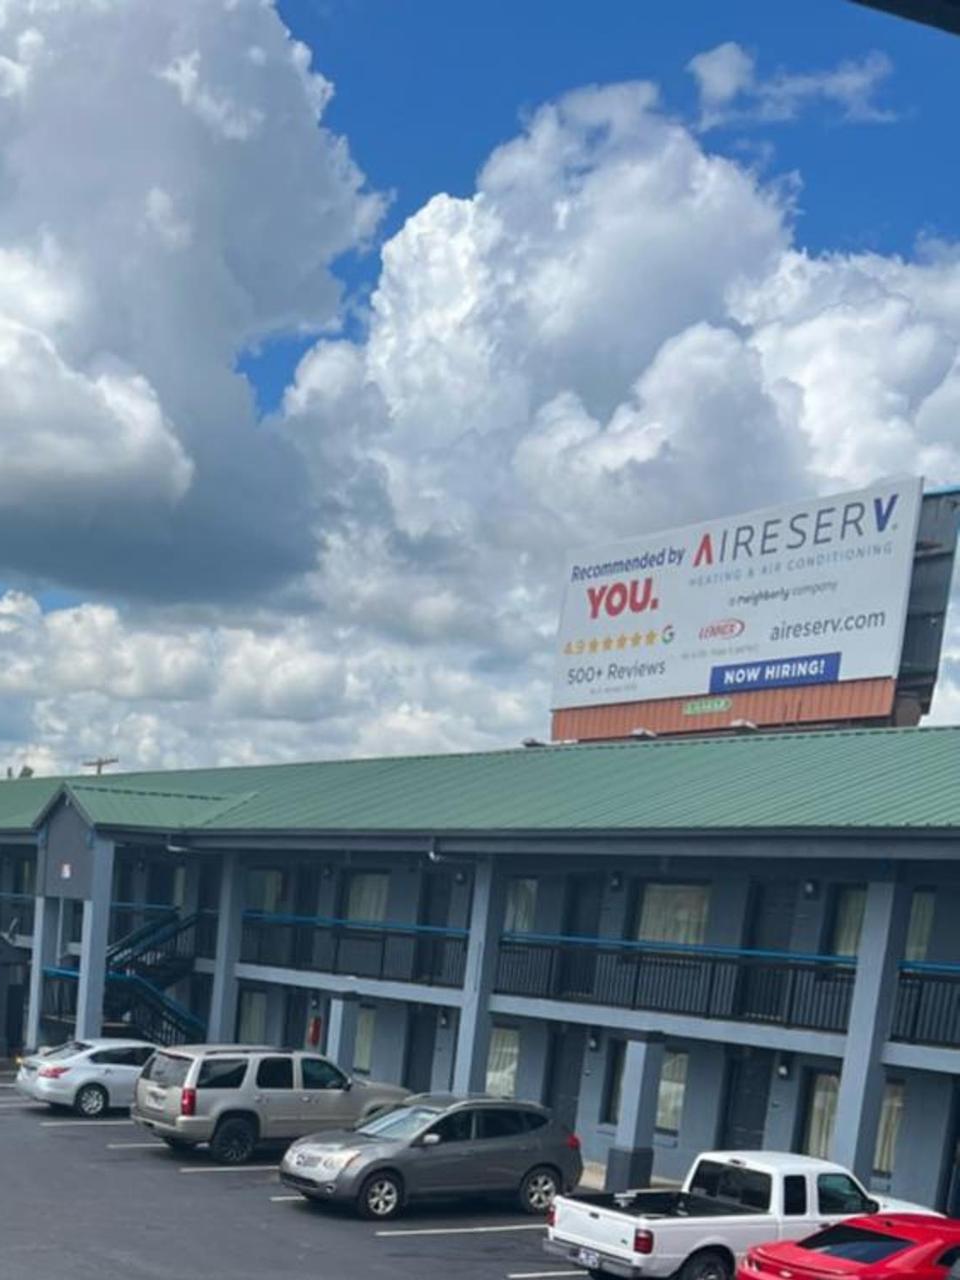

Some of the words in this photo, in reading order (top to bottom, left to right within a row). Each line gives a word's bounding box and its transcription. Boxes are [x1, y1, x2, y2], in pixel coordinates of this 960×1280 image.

[571, 549, 666, 582] Recommended
[669, 546, 687, 566] by
[689, 568, 742, 587] HEATING
[762, 561, 782, 576] AIR
[786, 543, 892, 572] CONDITIONING
[587, 577, 660, 619] YOU.
[791, 580, 838, 597] company
[769, 610, 886, 642] aireserv.com
[567, 665, 603, 685] 500+
[607, 660, 667, 680] Reviews
[723, 667, 760, 685] NOW
[763, 659, 826, 680] HIRING!
